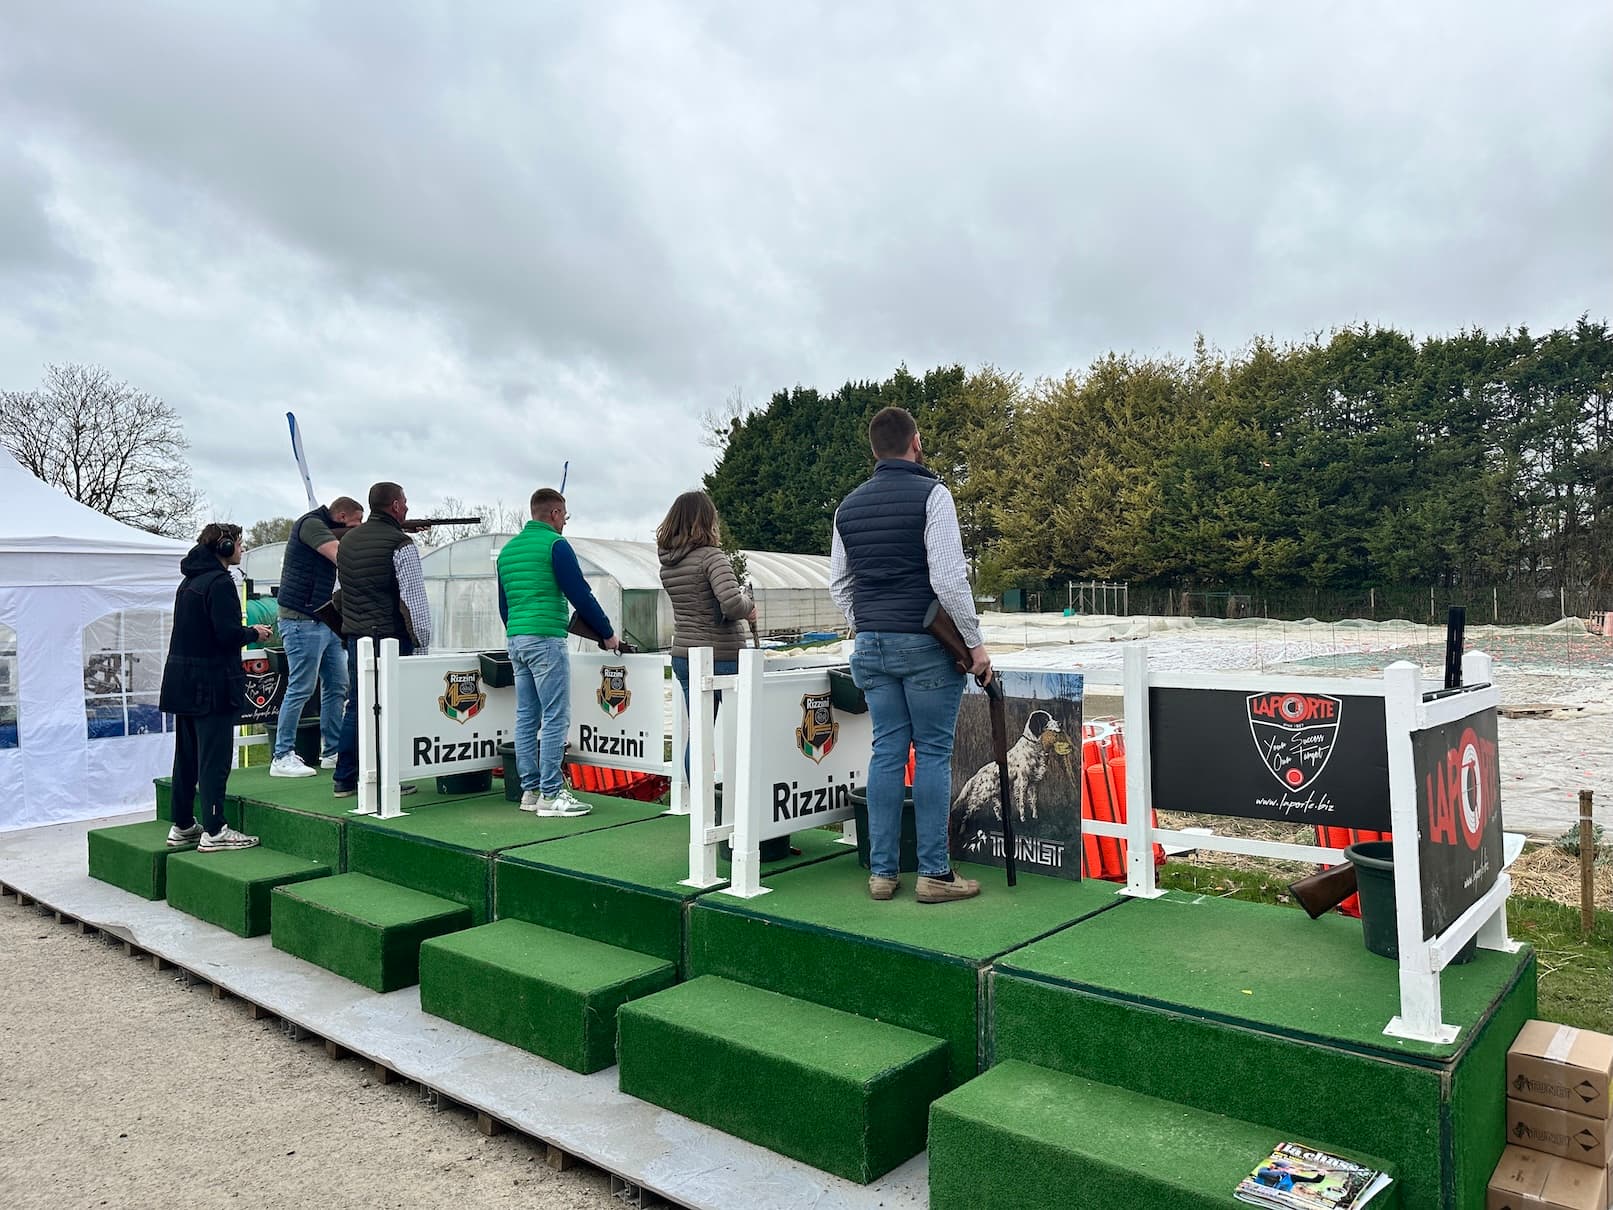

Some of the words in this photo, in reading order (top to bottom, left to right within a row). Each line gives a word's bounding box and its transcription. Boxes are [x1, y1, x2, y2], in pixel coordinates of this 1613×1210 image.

[450, 673, 476, 683] Rizzini
[604, 668, 624, 678] Rizzini
[1252, 692, 1335, 723] LAPORTE
[579, 724, 644, 758] Rizzini
[1263, 735, 1287, 760] Your
[1289, 732, 1325, 751] Success
[1273, 752, 1292, 771] Our
[1291, 745, 1330, 766] Target
[1255, 790, 1335, 815] www.laporte.biz
